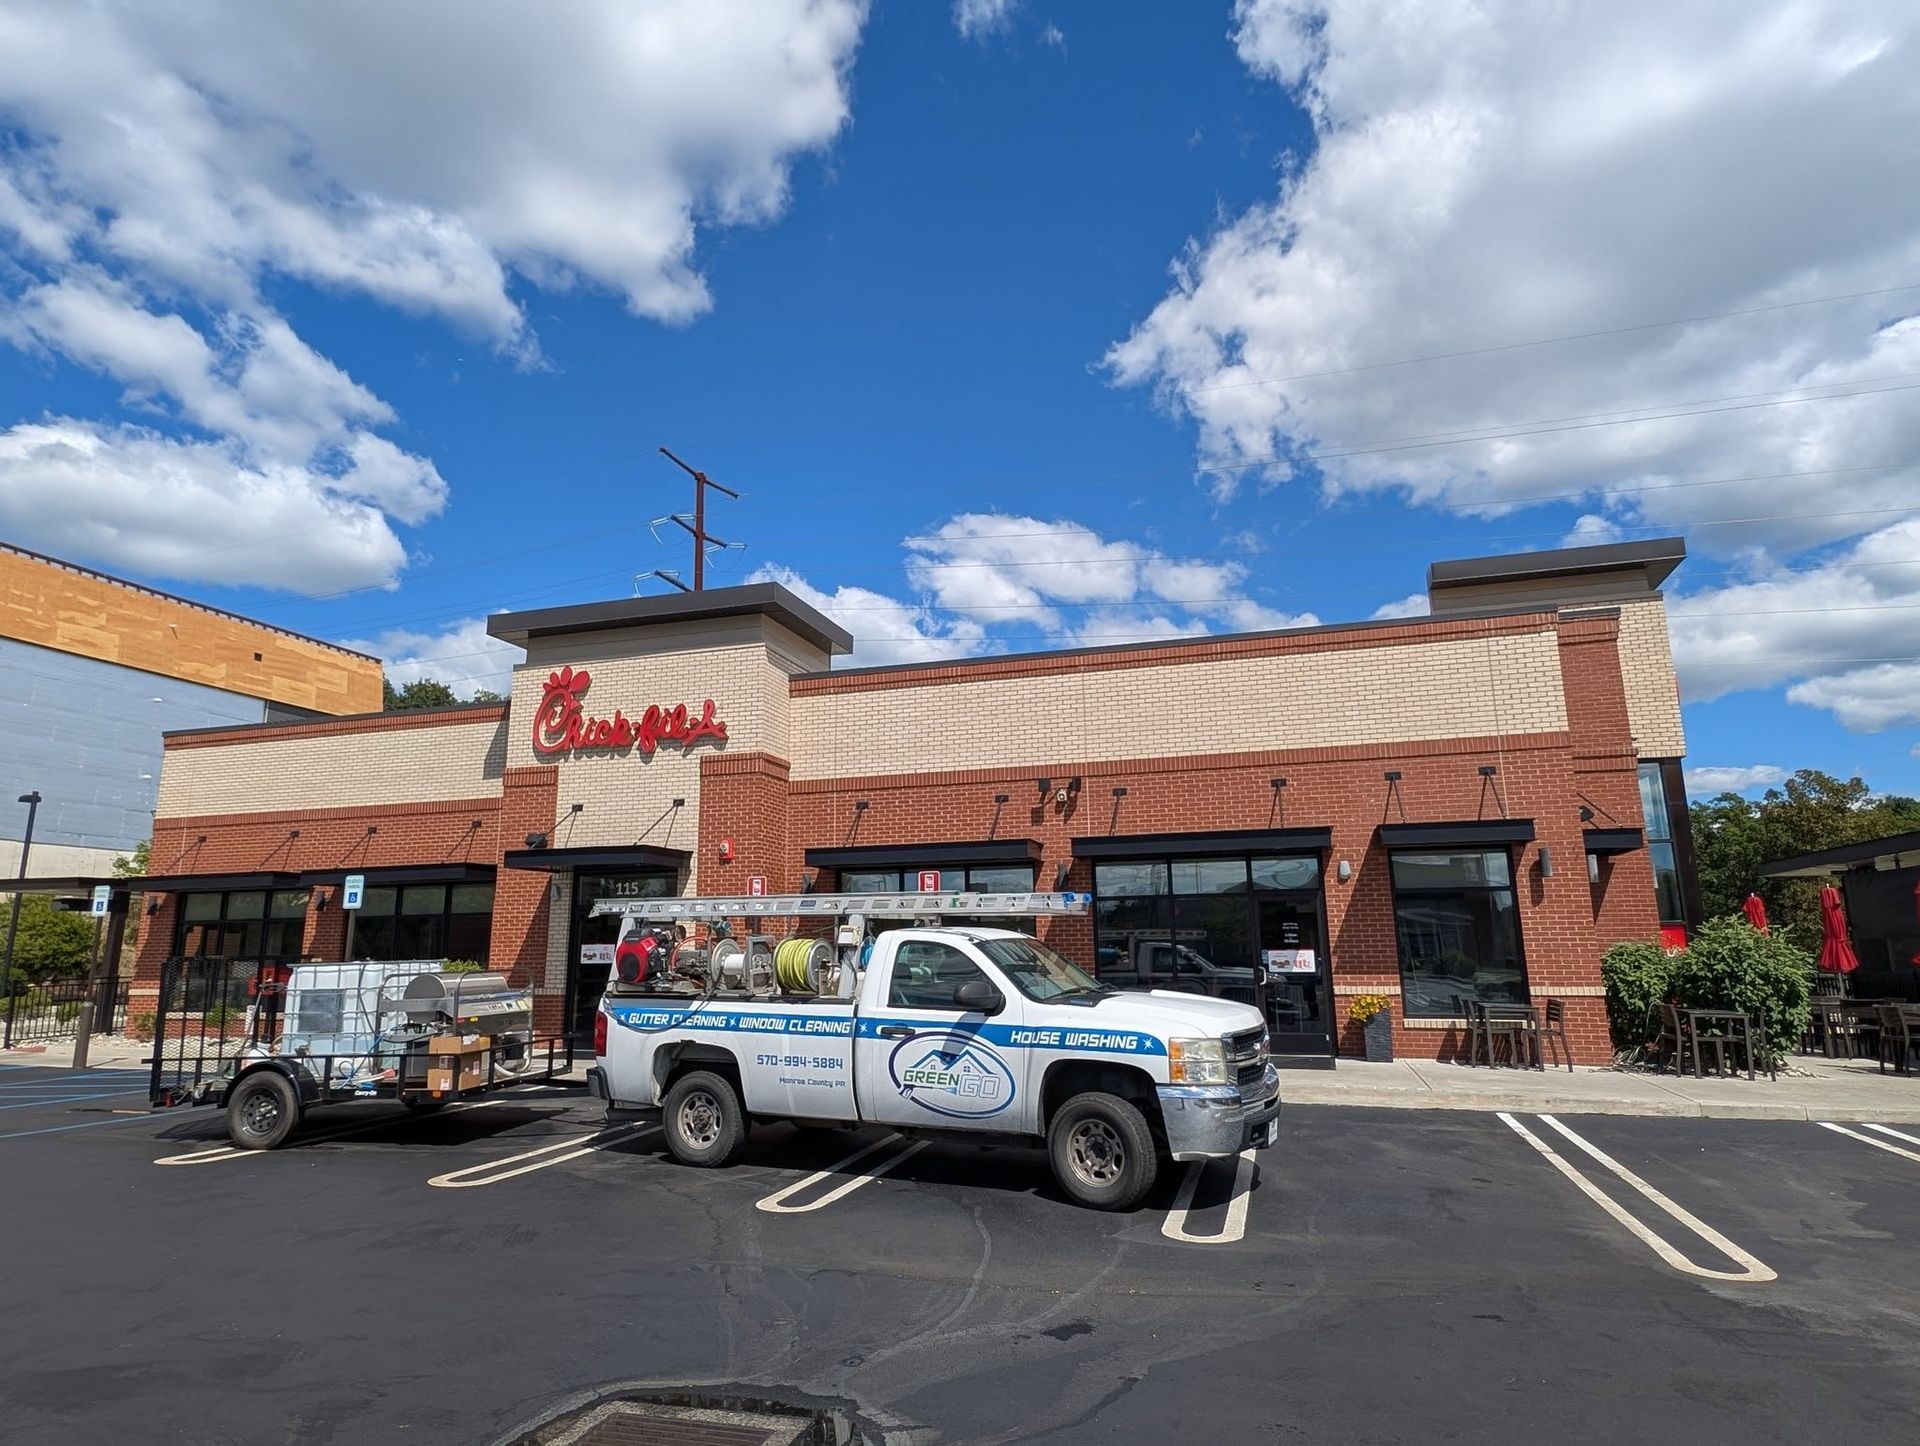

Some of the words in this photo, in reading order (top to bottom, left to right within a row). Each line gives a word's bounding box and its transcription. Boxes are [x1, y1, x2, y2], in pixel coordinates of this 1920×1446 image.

[533, 666, 729, 753] Chick-fil-A
[615, 882, 639, 895] 115
[628, 1013, 670, 1025] GUTTER
[671, 1013, 727, 1028] CLEANING
[739, 1016, 786, 1030] WINDOW
[789, 1019, 851, 1033] CLEANING
[1010, 1030, 1061, 1045] HOUSE
[1064, 1033, 1138, 1049] WASHING
[757, 1054, 843, 1069] 570-994-5884
[779, 1076, 806, 1086] Monroe
[807, 1078, 834, 1089] County
[835, 1080, 846, 1088] PA
[903, 1069, 960, 1087] GREEN
[959, 1073, 1001, 1100] GO
